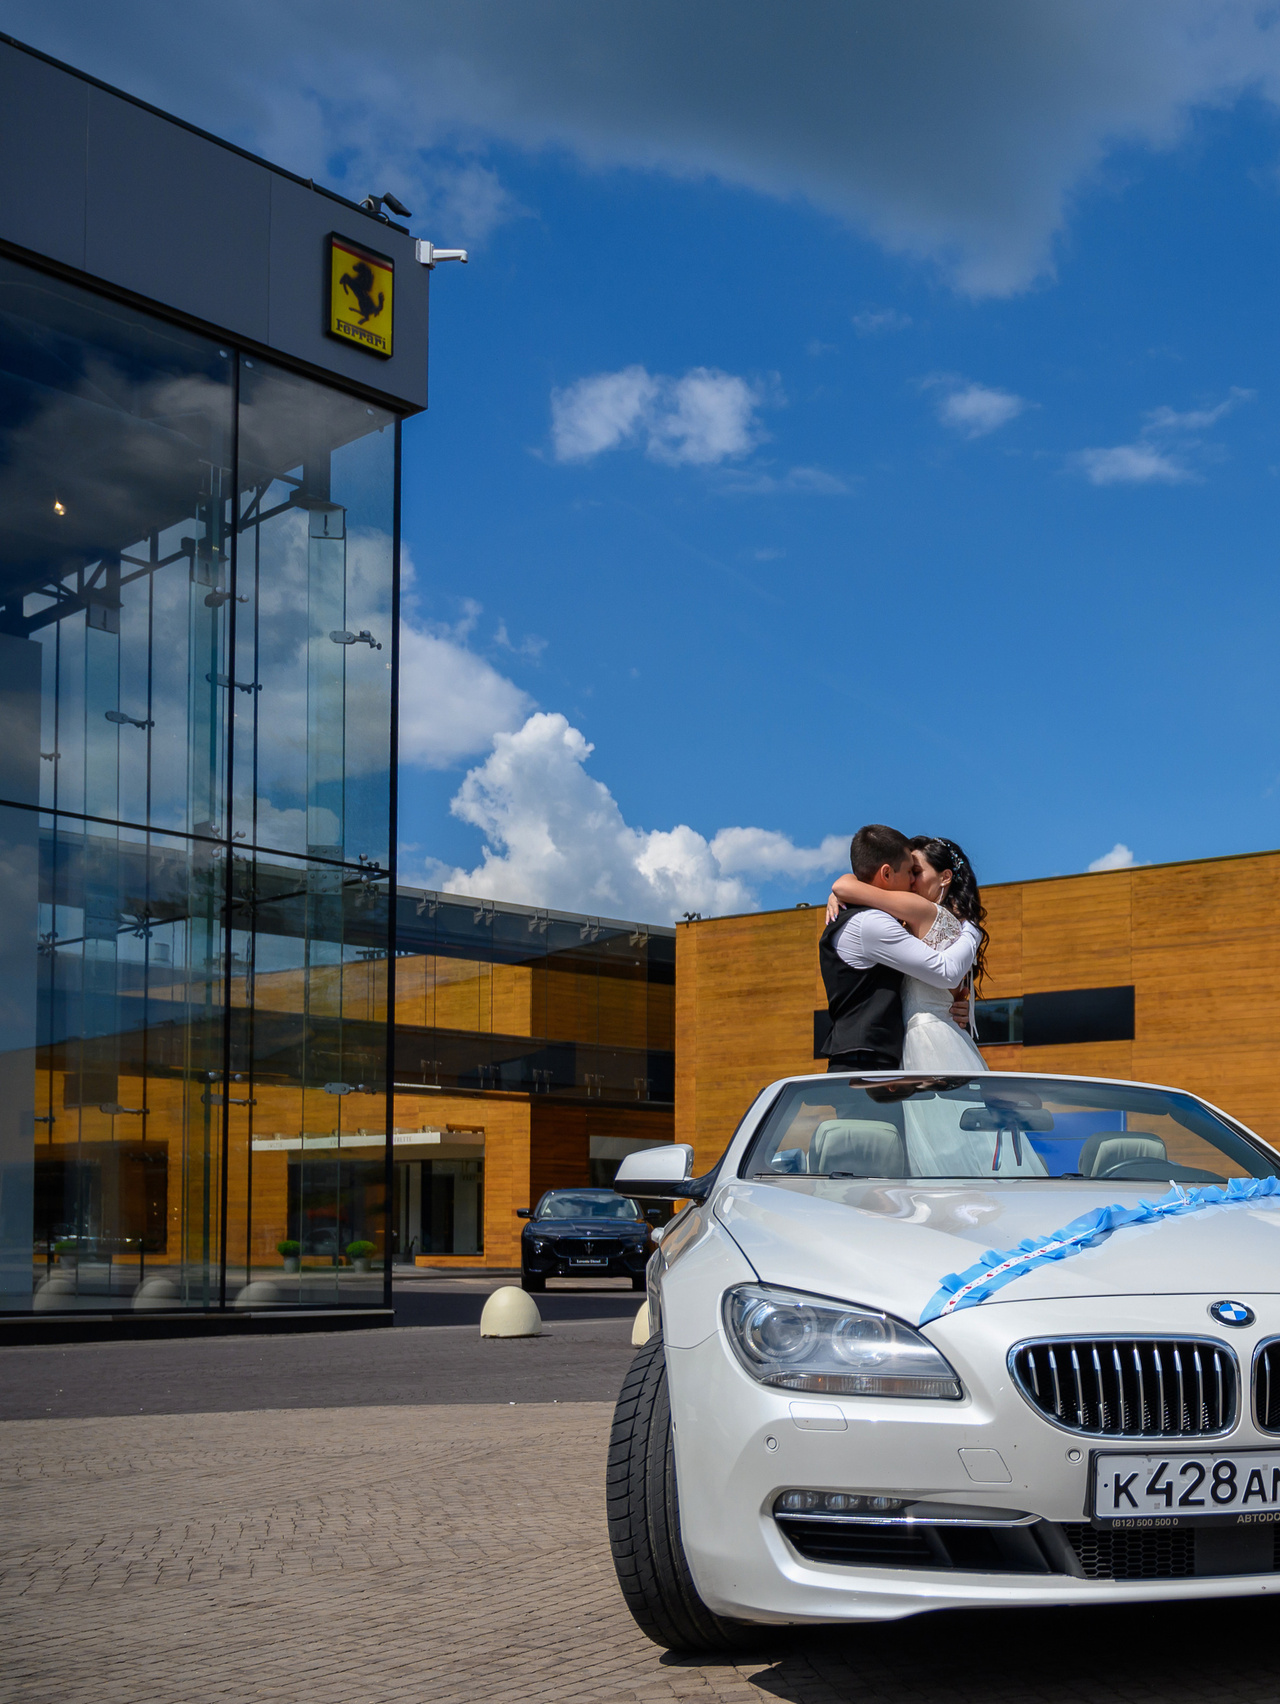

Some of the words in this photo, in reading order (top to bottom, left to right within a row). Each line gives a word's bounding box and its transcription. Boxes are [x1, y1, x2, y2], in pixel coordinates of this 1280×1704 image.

[336, 318, 386, 350] Ferrari
[1112, 1518, 1135, 1528] (812)
[1136, 1518, 1153, 1527] 500
[1154, 1517, 1171, 1526] 500
[1172, 1516, 1179, 1526] 0
